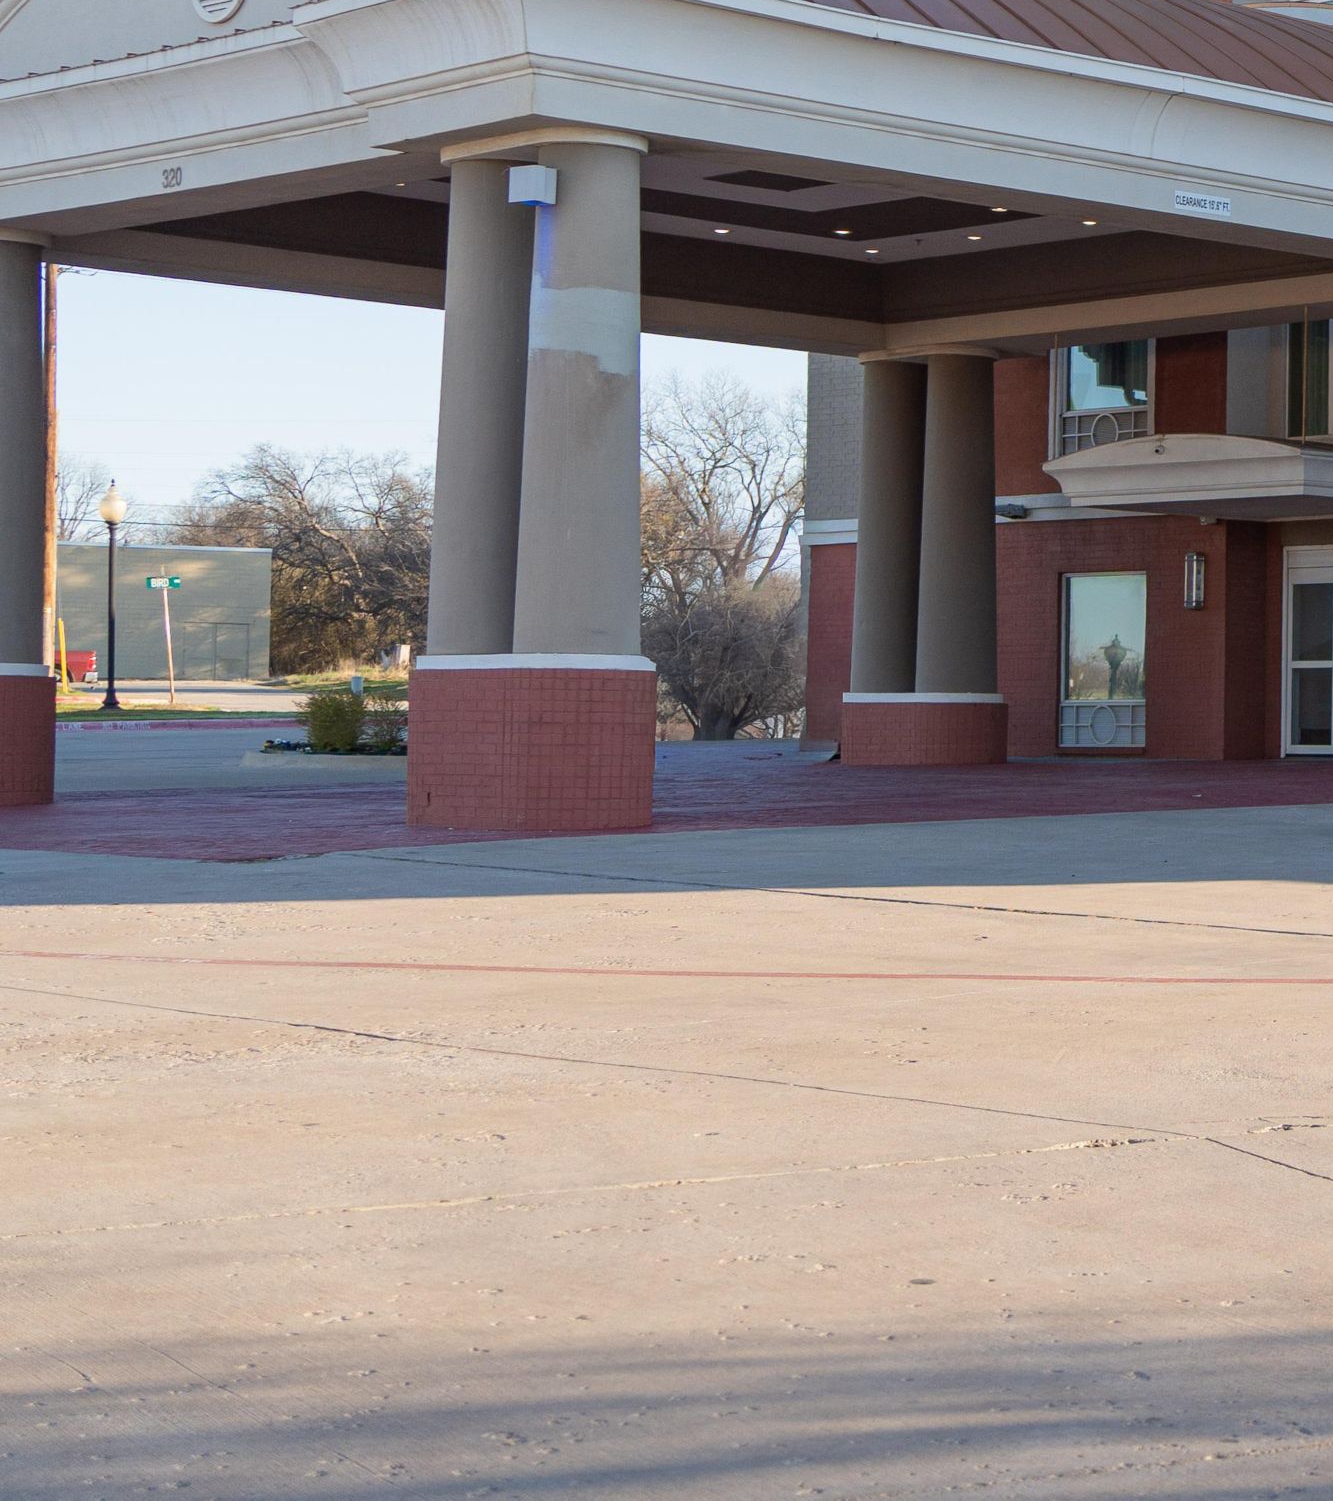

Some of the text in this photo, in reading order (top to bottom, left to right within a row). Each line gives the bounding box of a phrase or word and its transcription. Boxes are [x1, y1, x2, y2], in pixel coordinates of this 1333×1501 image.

[162, 166, 182, 189] 320
[1175, 194, 1208, 209] CLEARANCE
[150, 578, 169, 588] BIRD
